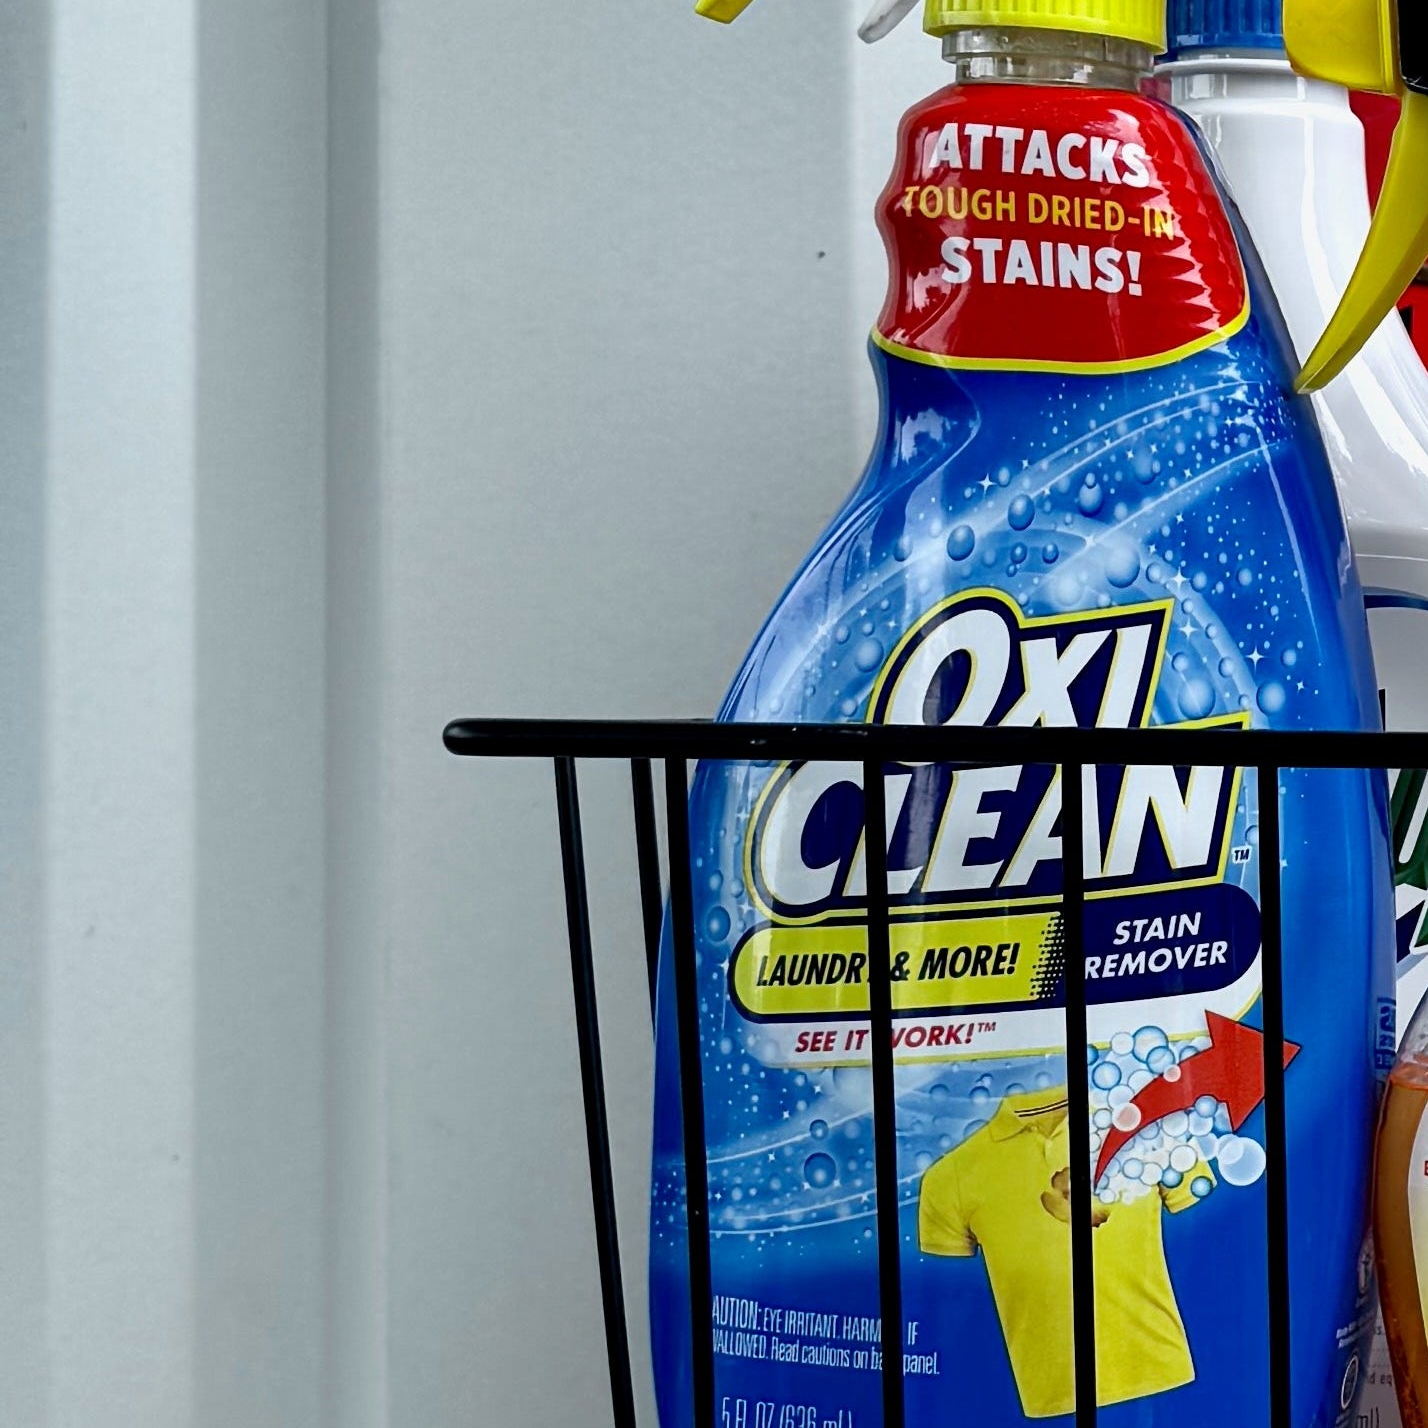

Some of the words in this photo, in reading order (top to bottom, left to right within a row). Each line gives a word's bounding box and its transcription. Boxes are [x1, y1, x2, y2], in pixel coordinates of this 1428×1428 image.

[929, 123, 1150, 188] ATTACKS
[905, 185, 1015, 222] TOUGH
[1028, 192, 1174, 240] DRIED-IN
[940, 236, 1142, 296] STAINS!
[885, 608, 1153, 728] OXI
[761, 760, 1225, 907] CLEAN
[1113, 912, 1202, 945] STAIN
[756, 955, 867, 987] LAUNDR
[889, 951, 909, 982] &
[917, 942, 1020, 980] MORE!
[1084, 940, 1228, 980] REMOVER
[795, 1030, 836, 1053] SEE
[844, 1029, 869, 1050] IT
[712, 1295, 761, 1330] AUTION:
[763, 1307, 783, 1333] EYE
[784, 1310, 841, 1339] IRRITANT.
[907, 1321, 919, 1345] IF
[771, 1337, 799, 1363] Read
[801, 1342, 850, 1368] cautions
[853, 1348, 869, 1370] on
[903, 1352, 940, 1376] panel.
